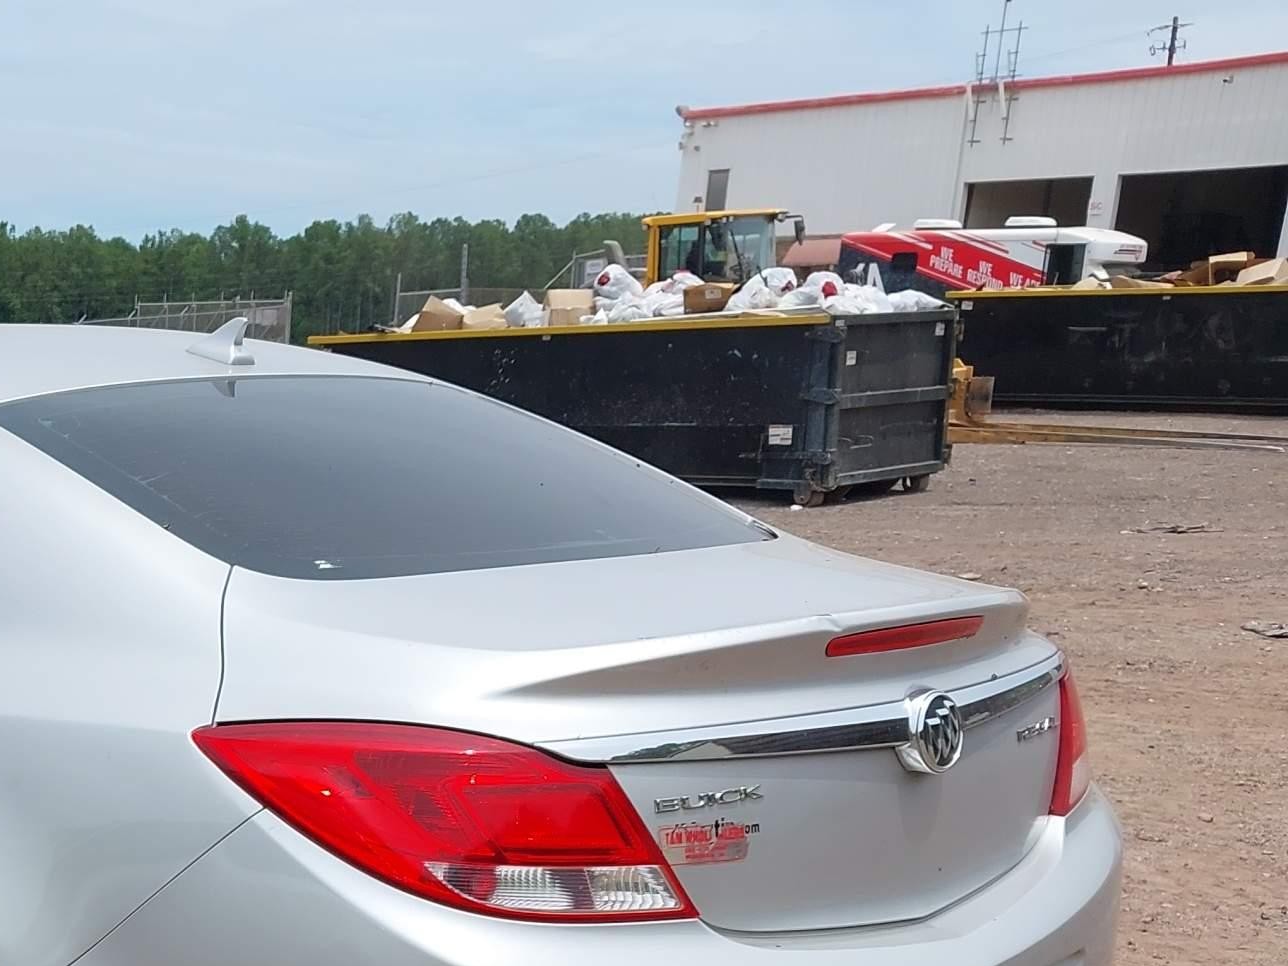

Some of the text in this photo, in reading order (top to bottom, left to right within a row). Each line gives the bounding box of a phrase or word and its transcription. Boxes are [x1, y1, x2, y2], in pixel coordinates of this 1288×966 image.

[941, 246, 954, 260] WE
[929, 255, 964, 279] PREPARE
[979, 260, 993, 276] WE
[967, 269, 1003, 289] RESPOND
[1010, 272, 1023, 289] WE
[654, 784, 763, 814] BUICK
